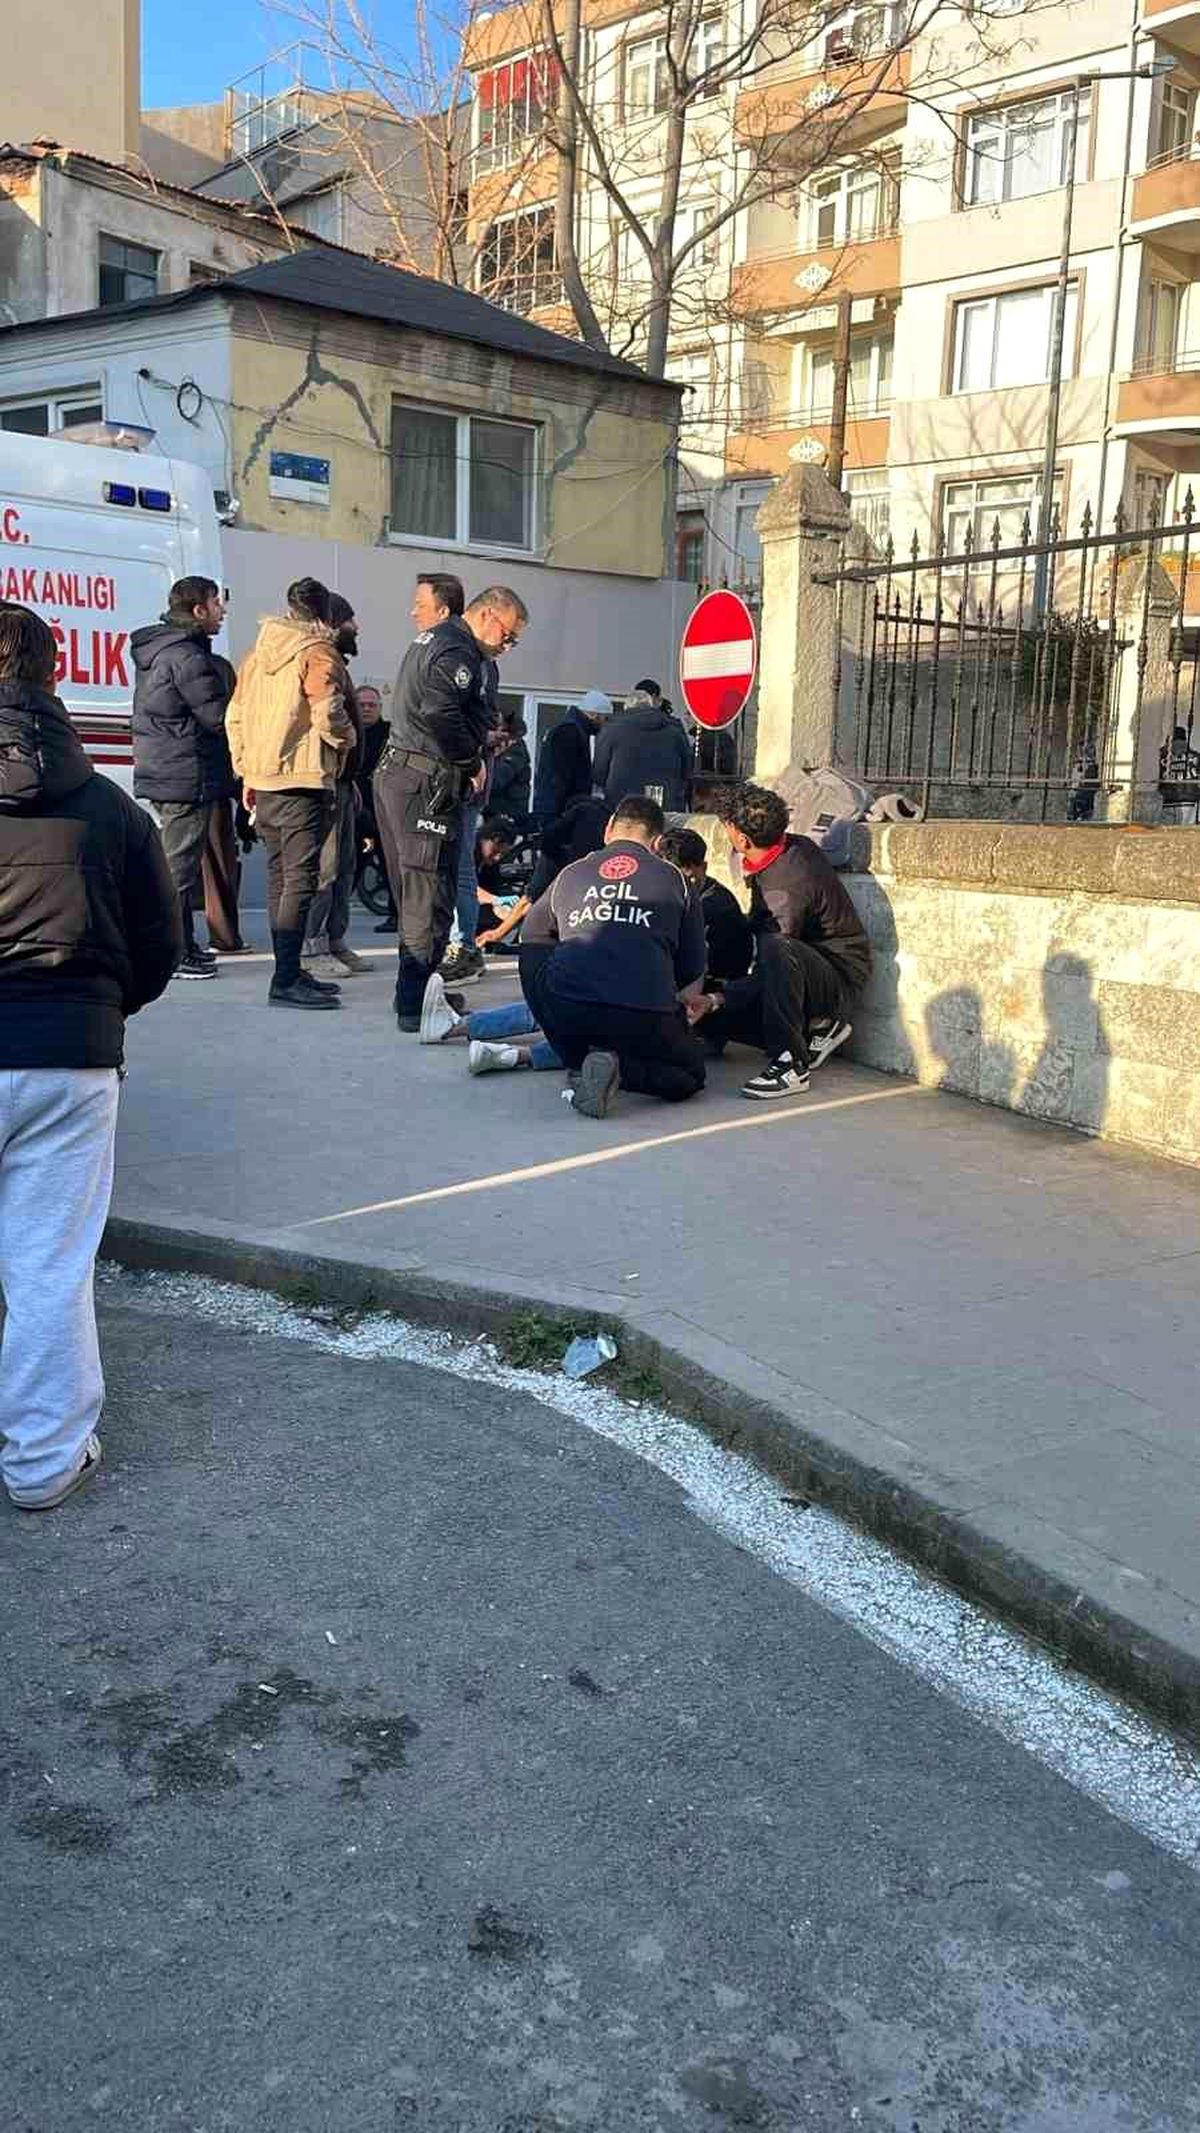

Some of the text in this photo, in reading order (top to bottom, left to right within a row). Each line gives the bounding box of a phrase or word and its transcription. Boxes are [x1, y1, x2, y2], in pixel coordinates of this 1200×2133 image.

[0, 567, 114, 611] AKANLIĞI
[50, 618, 129, 687] ĞLIK
[568, 901, 654, 928] SAĞLIK
